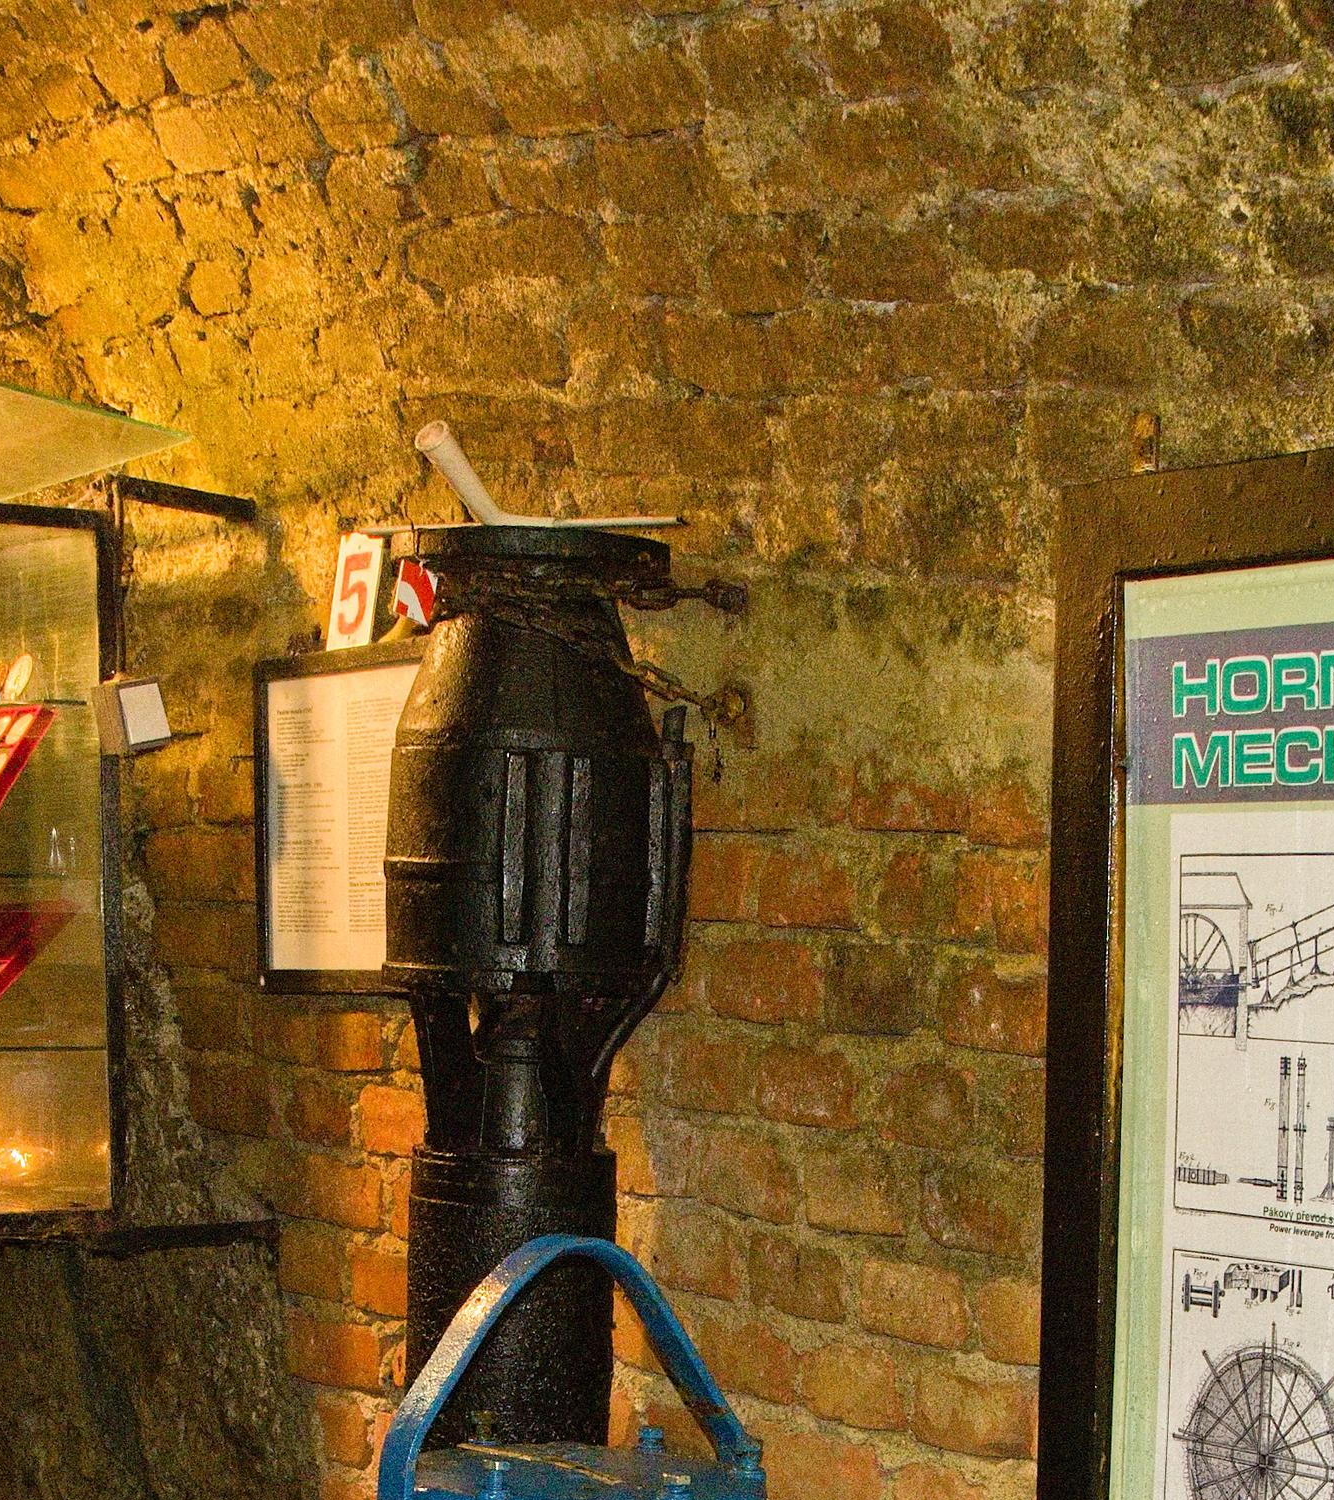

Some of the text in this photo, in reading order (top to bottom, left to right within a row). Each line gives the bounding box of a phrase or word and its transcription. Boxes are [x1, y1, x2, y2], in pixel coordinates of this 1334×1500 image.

[338, 552, 372, 635] 5
[1263, 1206, 1294, 1220] Pákový
[1269, 1223, 1291, 1235] Power
[1293, 1226, 1324, 1240] leverage
